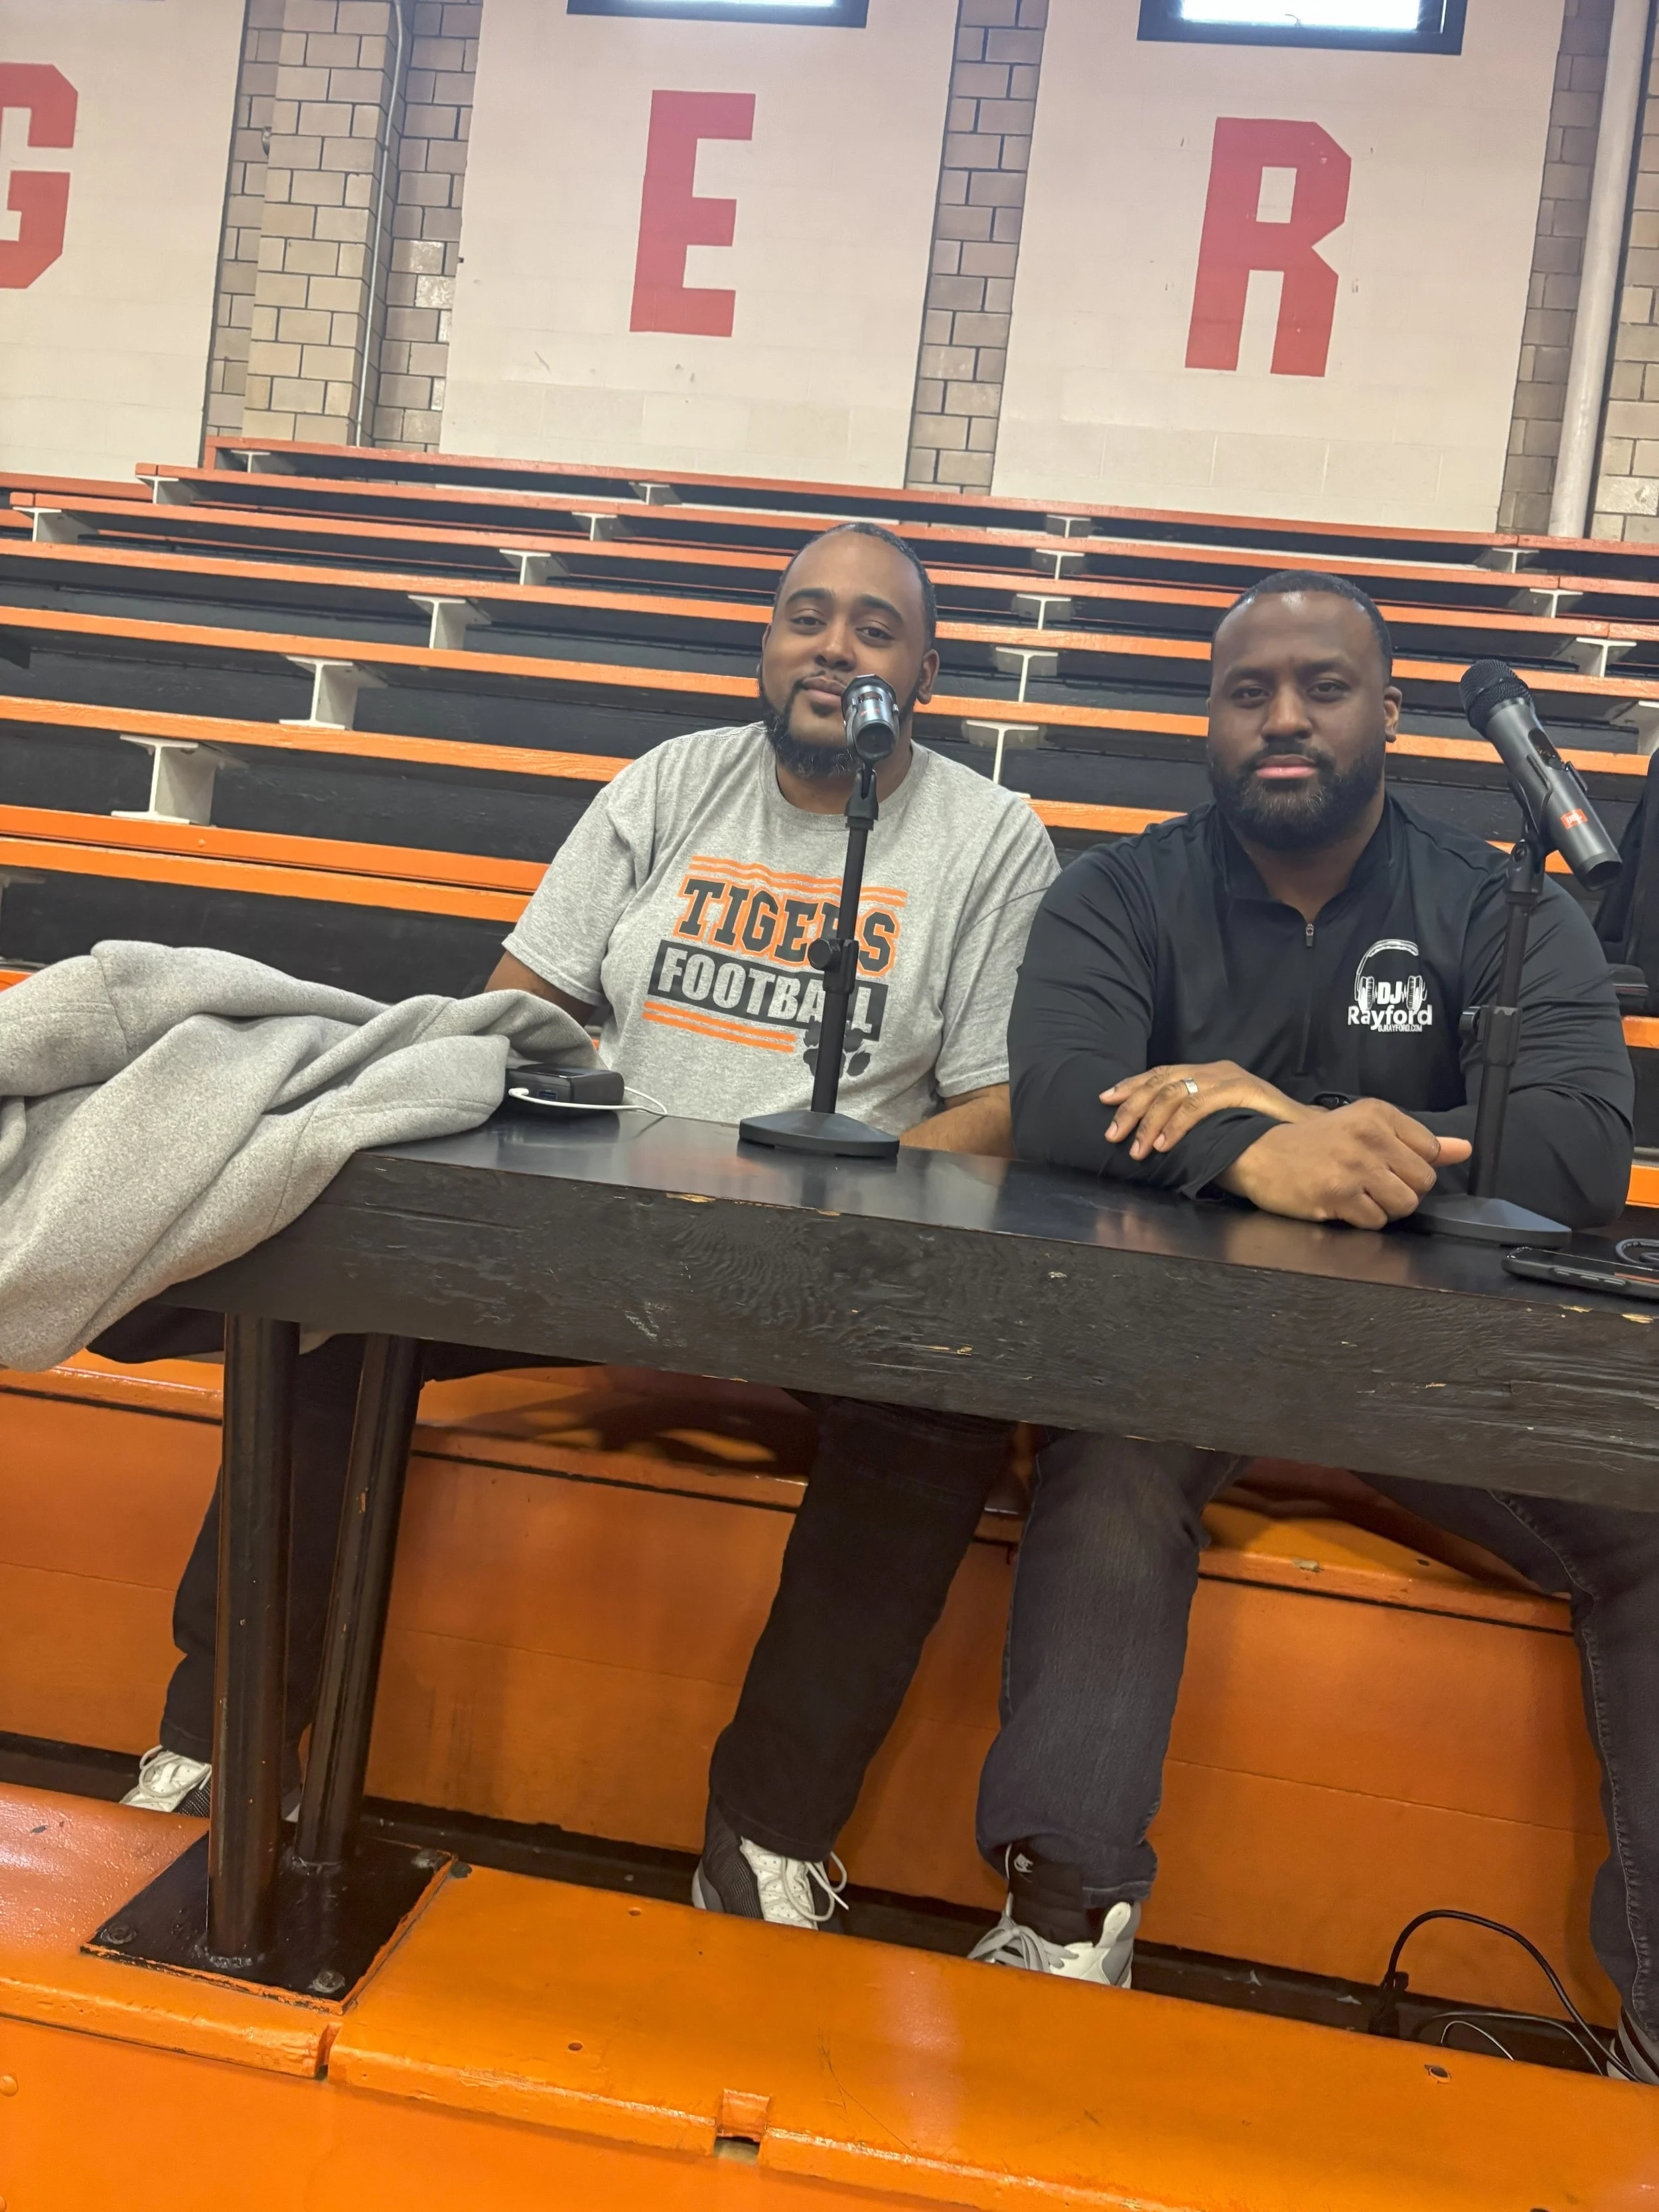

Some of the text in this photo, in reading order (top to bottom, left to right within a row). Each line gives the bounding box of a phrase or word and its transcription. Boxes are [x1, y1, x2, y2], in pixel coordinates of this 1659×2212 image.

[630, 90, 756, 337] E
[1185, 117, 1352, 377] R
[657, 946, 873, 1033] FOOTBAL
[1348, 1004, 1432, 1031] Rayford
[1377, 981, 1402, 1004] DJ
